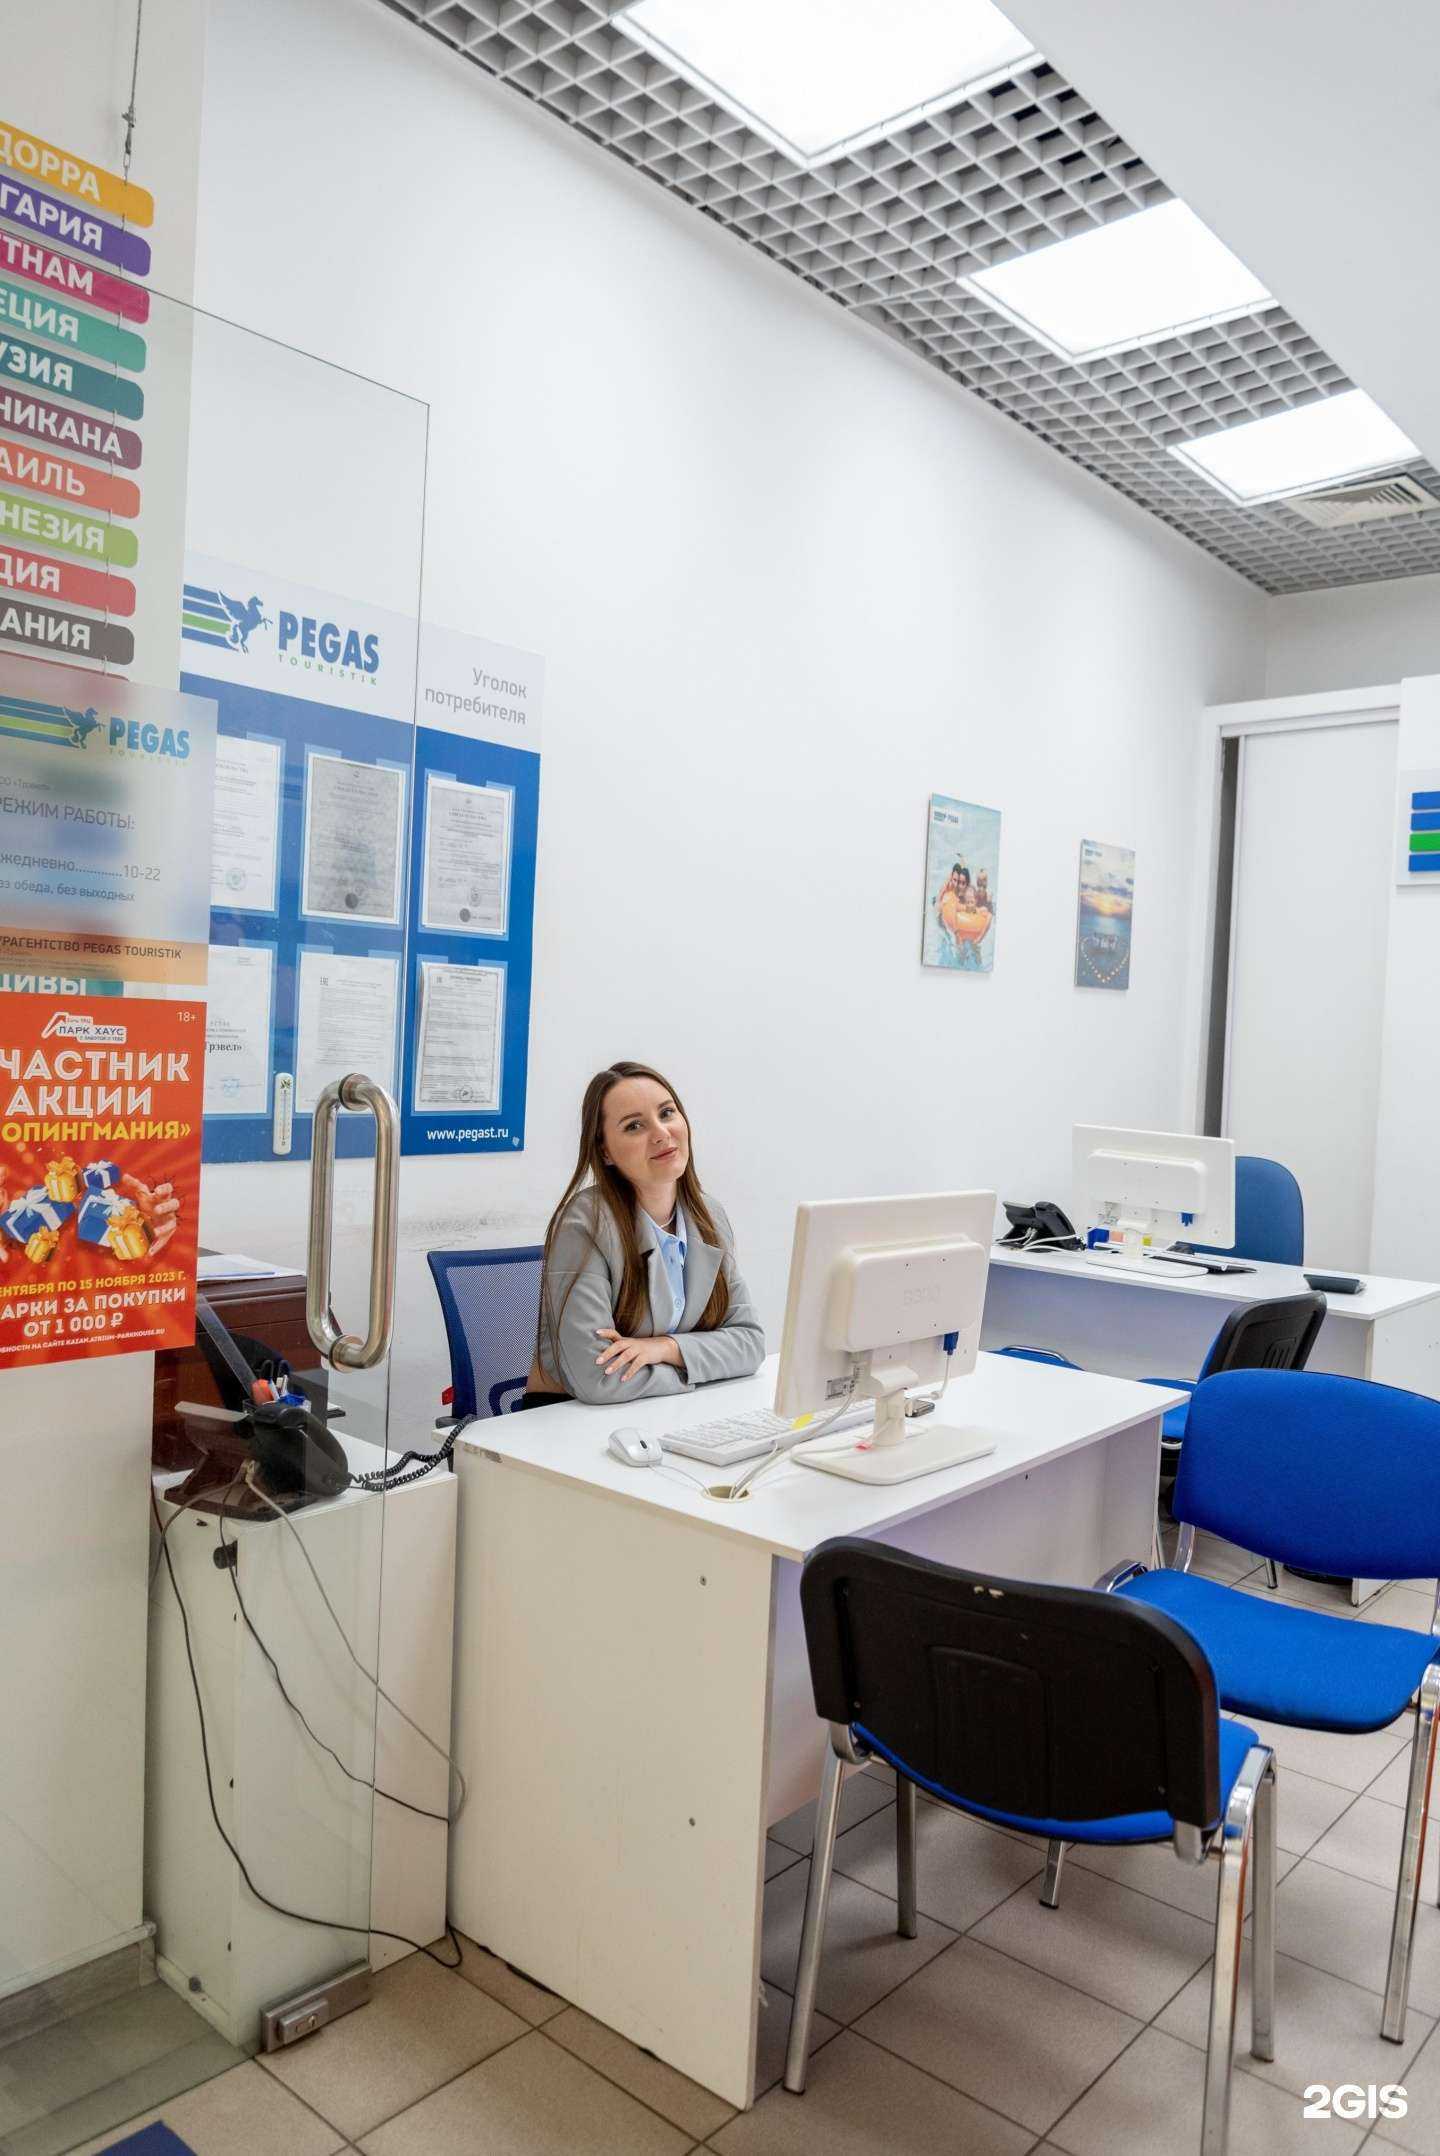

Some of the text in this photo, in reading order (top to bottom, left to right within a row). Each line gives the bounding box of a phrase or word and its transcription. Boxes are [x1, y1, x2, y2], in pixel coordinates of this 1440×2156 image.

[0, 183, 103, 251] ГАРИЯ
[0, 500, 105, 553] НЕЗИЯ
[0, 607, 91, 650] АНИЯ
[279, 610, 380, 675] PEGAS
[278, 653, 378, 686] TOURISTIK
[473, 667, 527, 699] Уголок
[425, 688, 527, 725] потребителя
[109, 716, 191, 760] PEGAS
[0, 796, 58, 819] ЕЖИМ
[83, 942, 121, 954] PEGAS
[123, 945, 182, 959] TOURISTIK
[59, 1026, 124, 1036] ПАРК ХАУС
[177, 1012, 197, 1023] 18+
[207, 1041, 242, 1054] рэвел»
[0, 1049, 191, 1082] ЧАСТНИК
[5, 1085, 152, 1118] АКЦИИ
[1, 1120, 192, 1143] ОПИНГМАНИЯ»
[426, 1126, 509, 1143] www.pegast.ru
[57, 1280, 77, 1292] ПО
[79, 1278, 93, 1290] 15
[95, 1274, 146, 1288] НОЯБРЯ
[148, 1271, 175, 1283] 2023
[176, 1270, 187, 1281] Г.
[0, 1287, 187, 1320] АРКИ ЗА ПОКУПКИ
[23, 1319, 51, 1338] ОТ
[69, 1317, 106, 1333] 000
